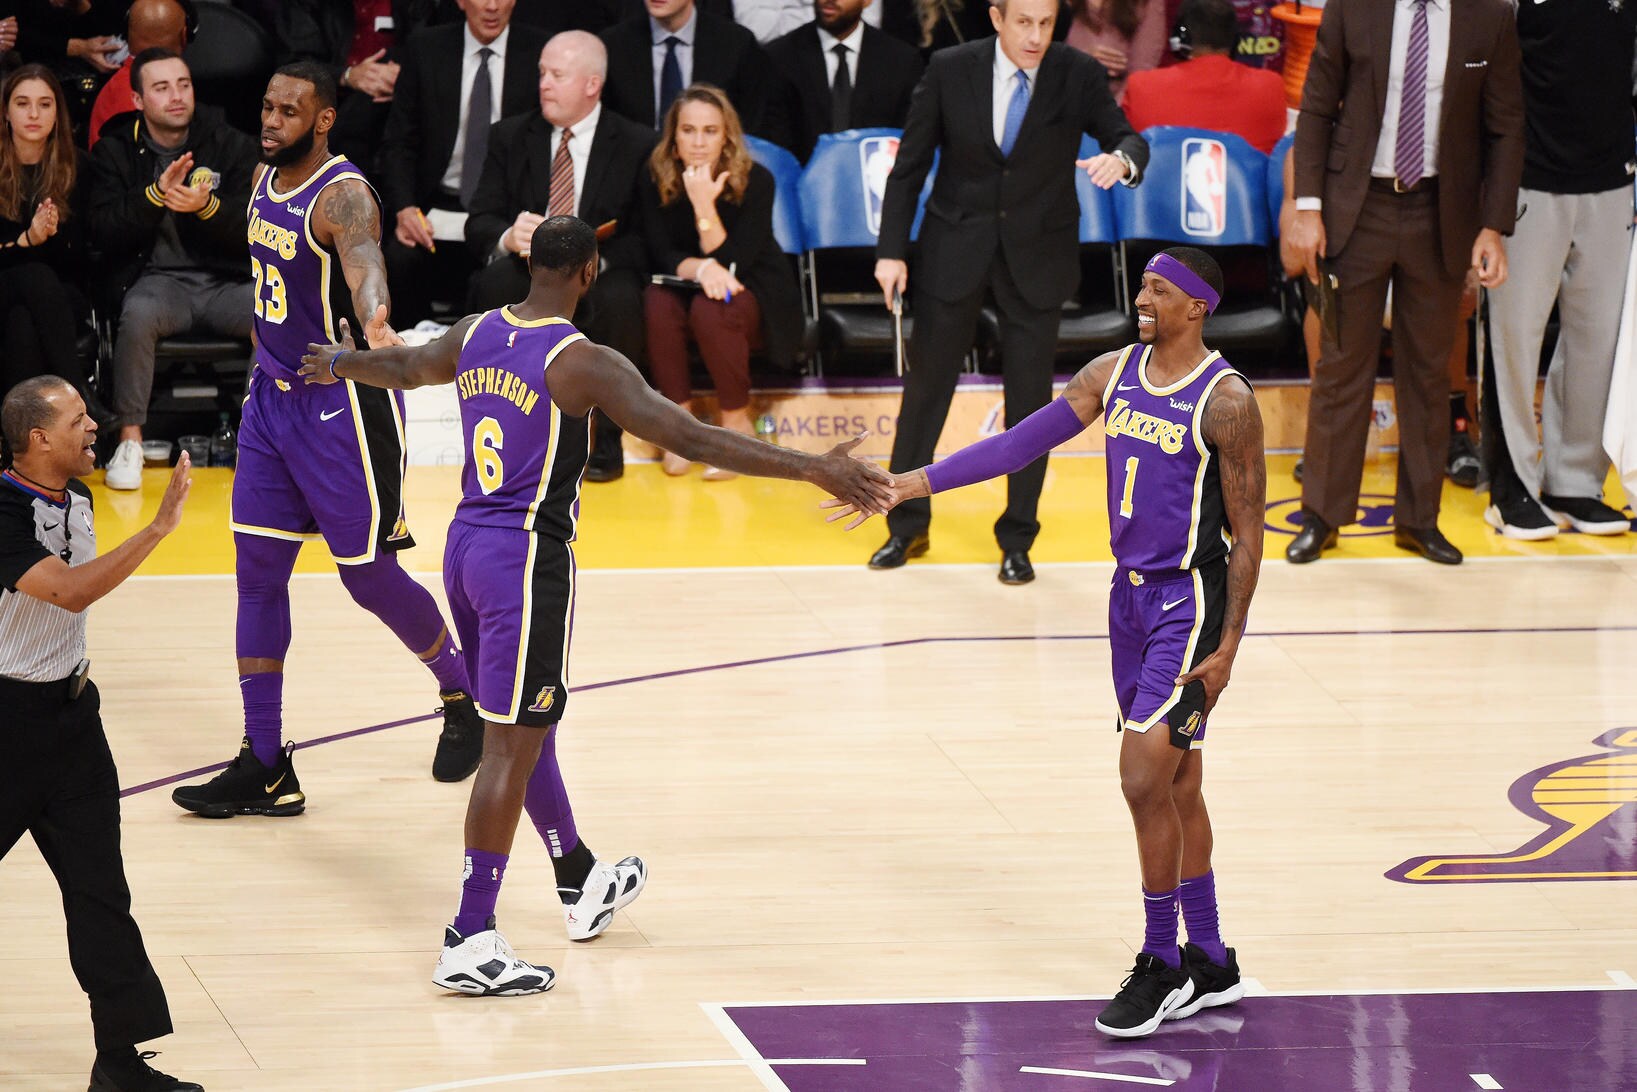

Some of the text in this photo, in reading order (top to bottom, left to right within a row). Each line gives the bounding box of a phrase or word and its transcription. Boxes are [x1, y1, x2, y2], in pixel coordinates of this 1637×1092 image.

[248, 207, 298, 260] LAKERS
[287, 202, 305, 218] wish
[251, 255, 288, 325] 23
[458, 367, 540, 416] STEPHENSON
[1169, 397, 1194, 413] wish
[779, 415, 898, 437] AKERS.C
[1105, 397, 1188, 455] LAKERS
[473, 416, 504, 496] 6
[1119, 456, 1140, 519] 1
